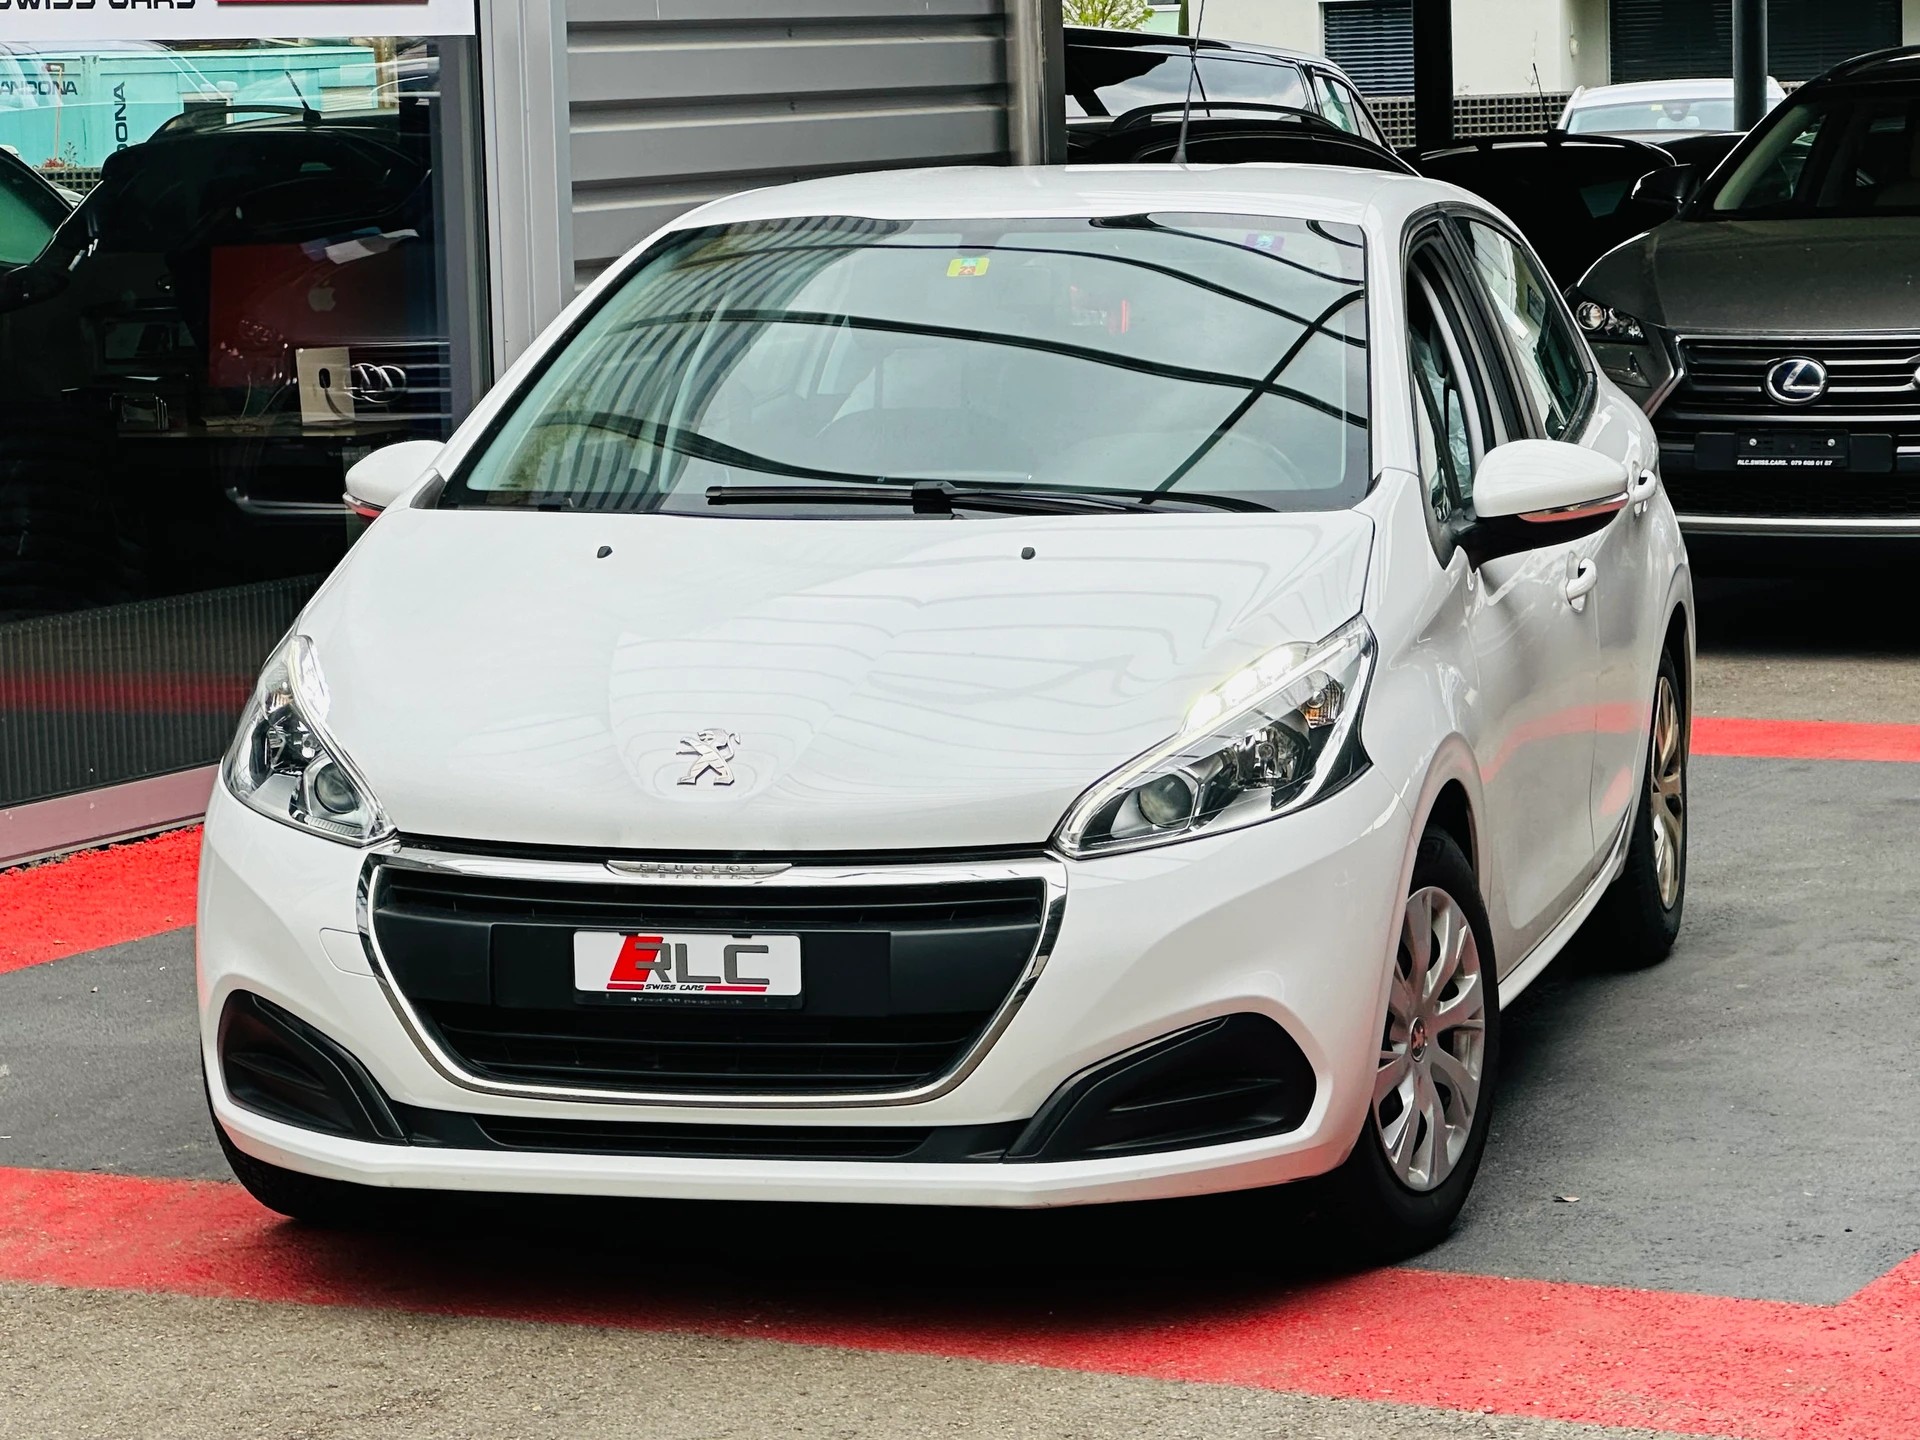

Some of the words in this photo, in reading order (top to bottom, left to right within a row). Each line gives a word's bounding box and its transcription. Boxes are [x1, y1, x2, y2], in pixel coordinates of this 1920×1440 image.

[634, 942, 770, 985] RLC
[644, 983, 676, 992] SWISS
[679, 984, 705, 992] CARS
